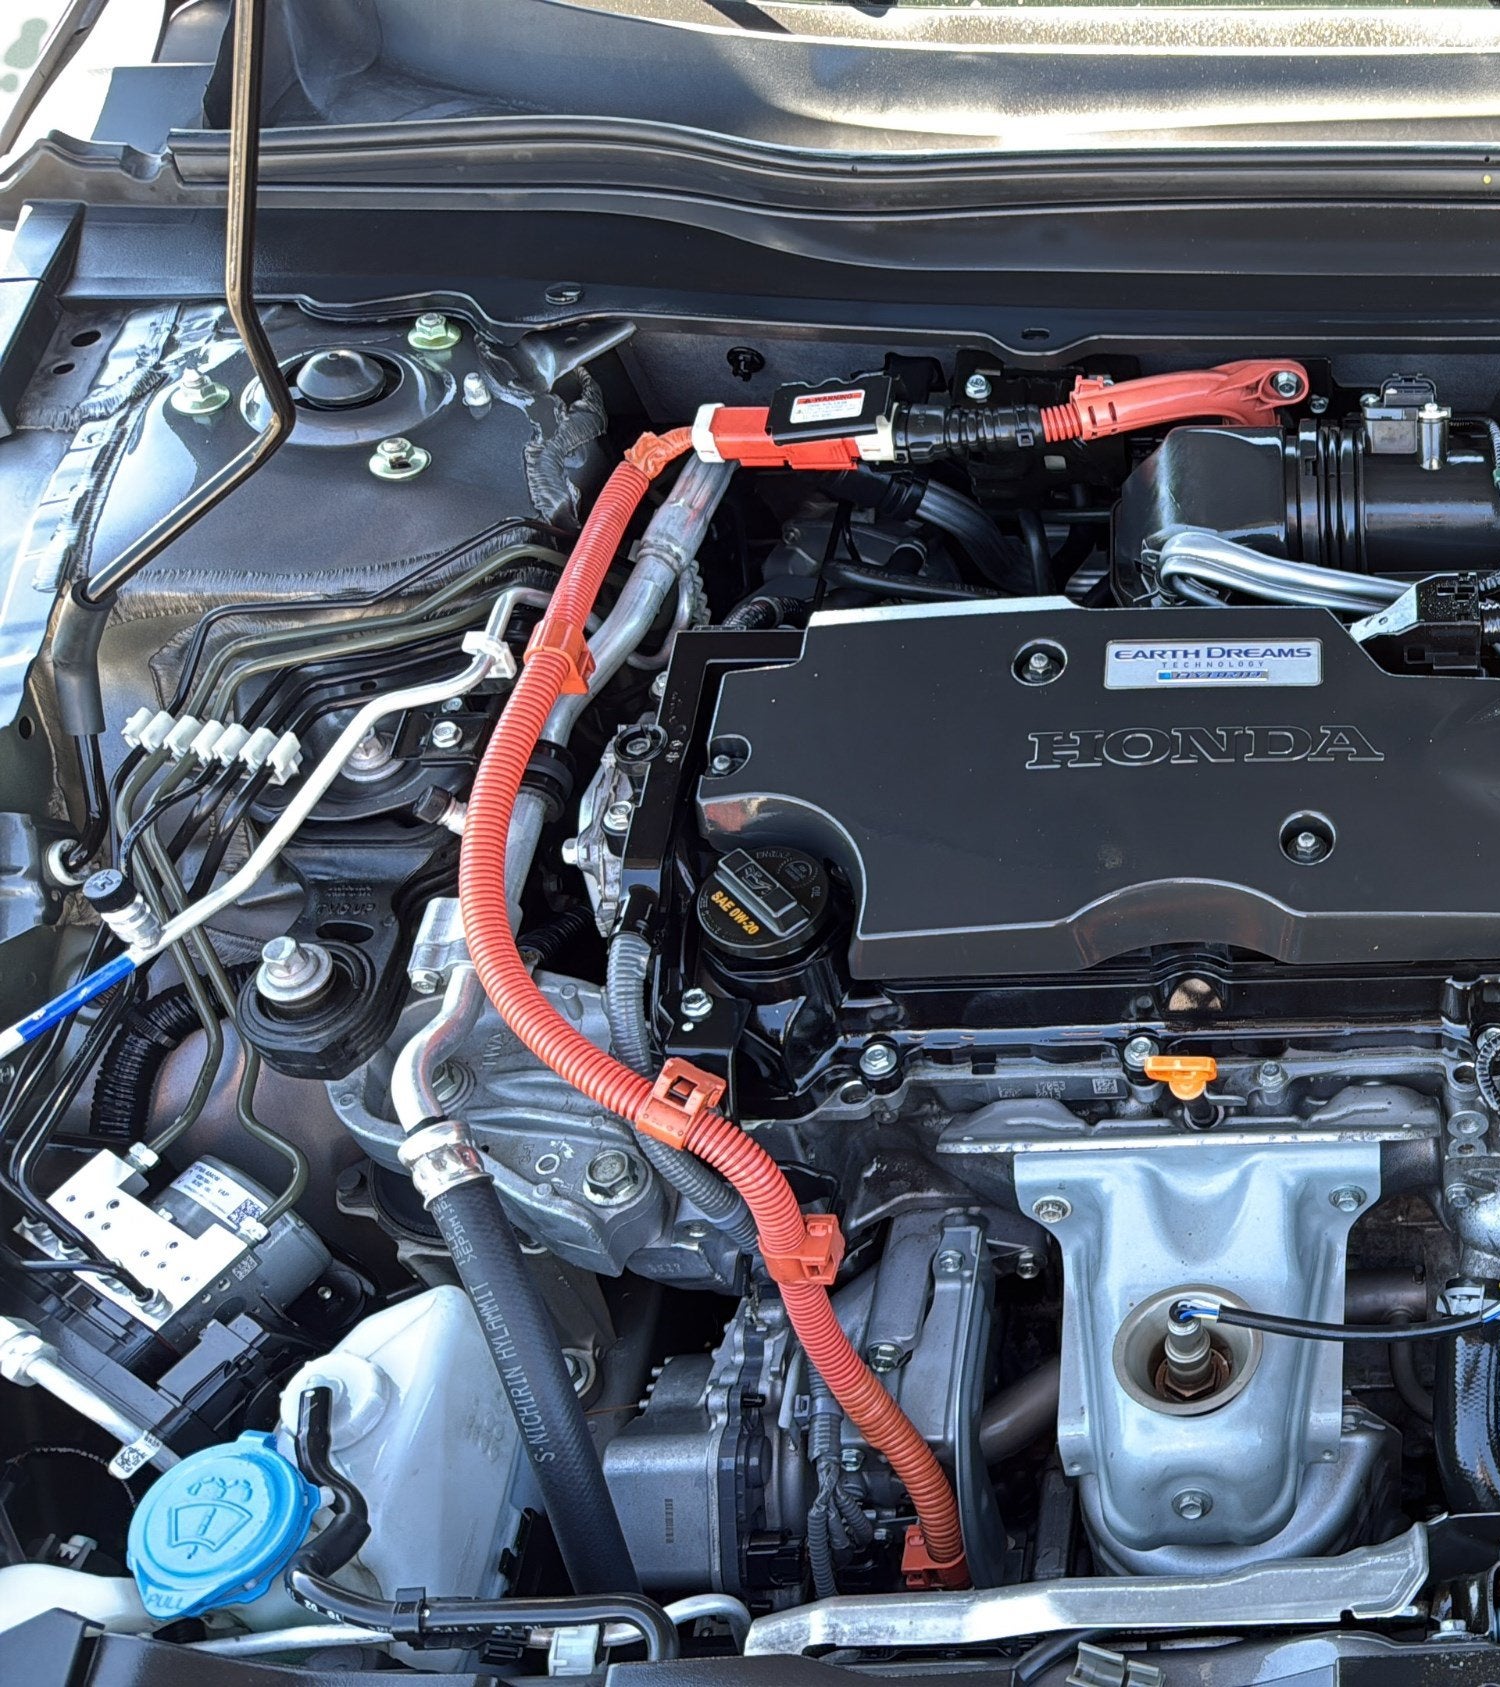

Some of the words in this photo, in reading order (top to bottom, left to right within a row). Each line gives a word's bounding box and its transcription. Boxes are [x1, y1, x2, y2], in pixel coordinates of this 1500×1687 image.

[1115, 647, 1200, 659] EARTH
[1206, 647, 1311, 659] DREAMS
[1025, 725, 1384, 769] HONDA
[709, 888, 735, 914] SAE
[727, 905, 760, 937] 0W-20
[146, 1592, 184, 1610] PULL
